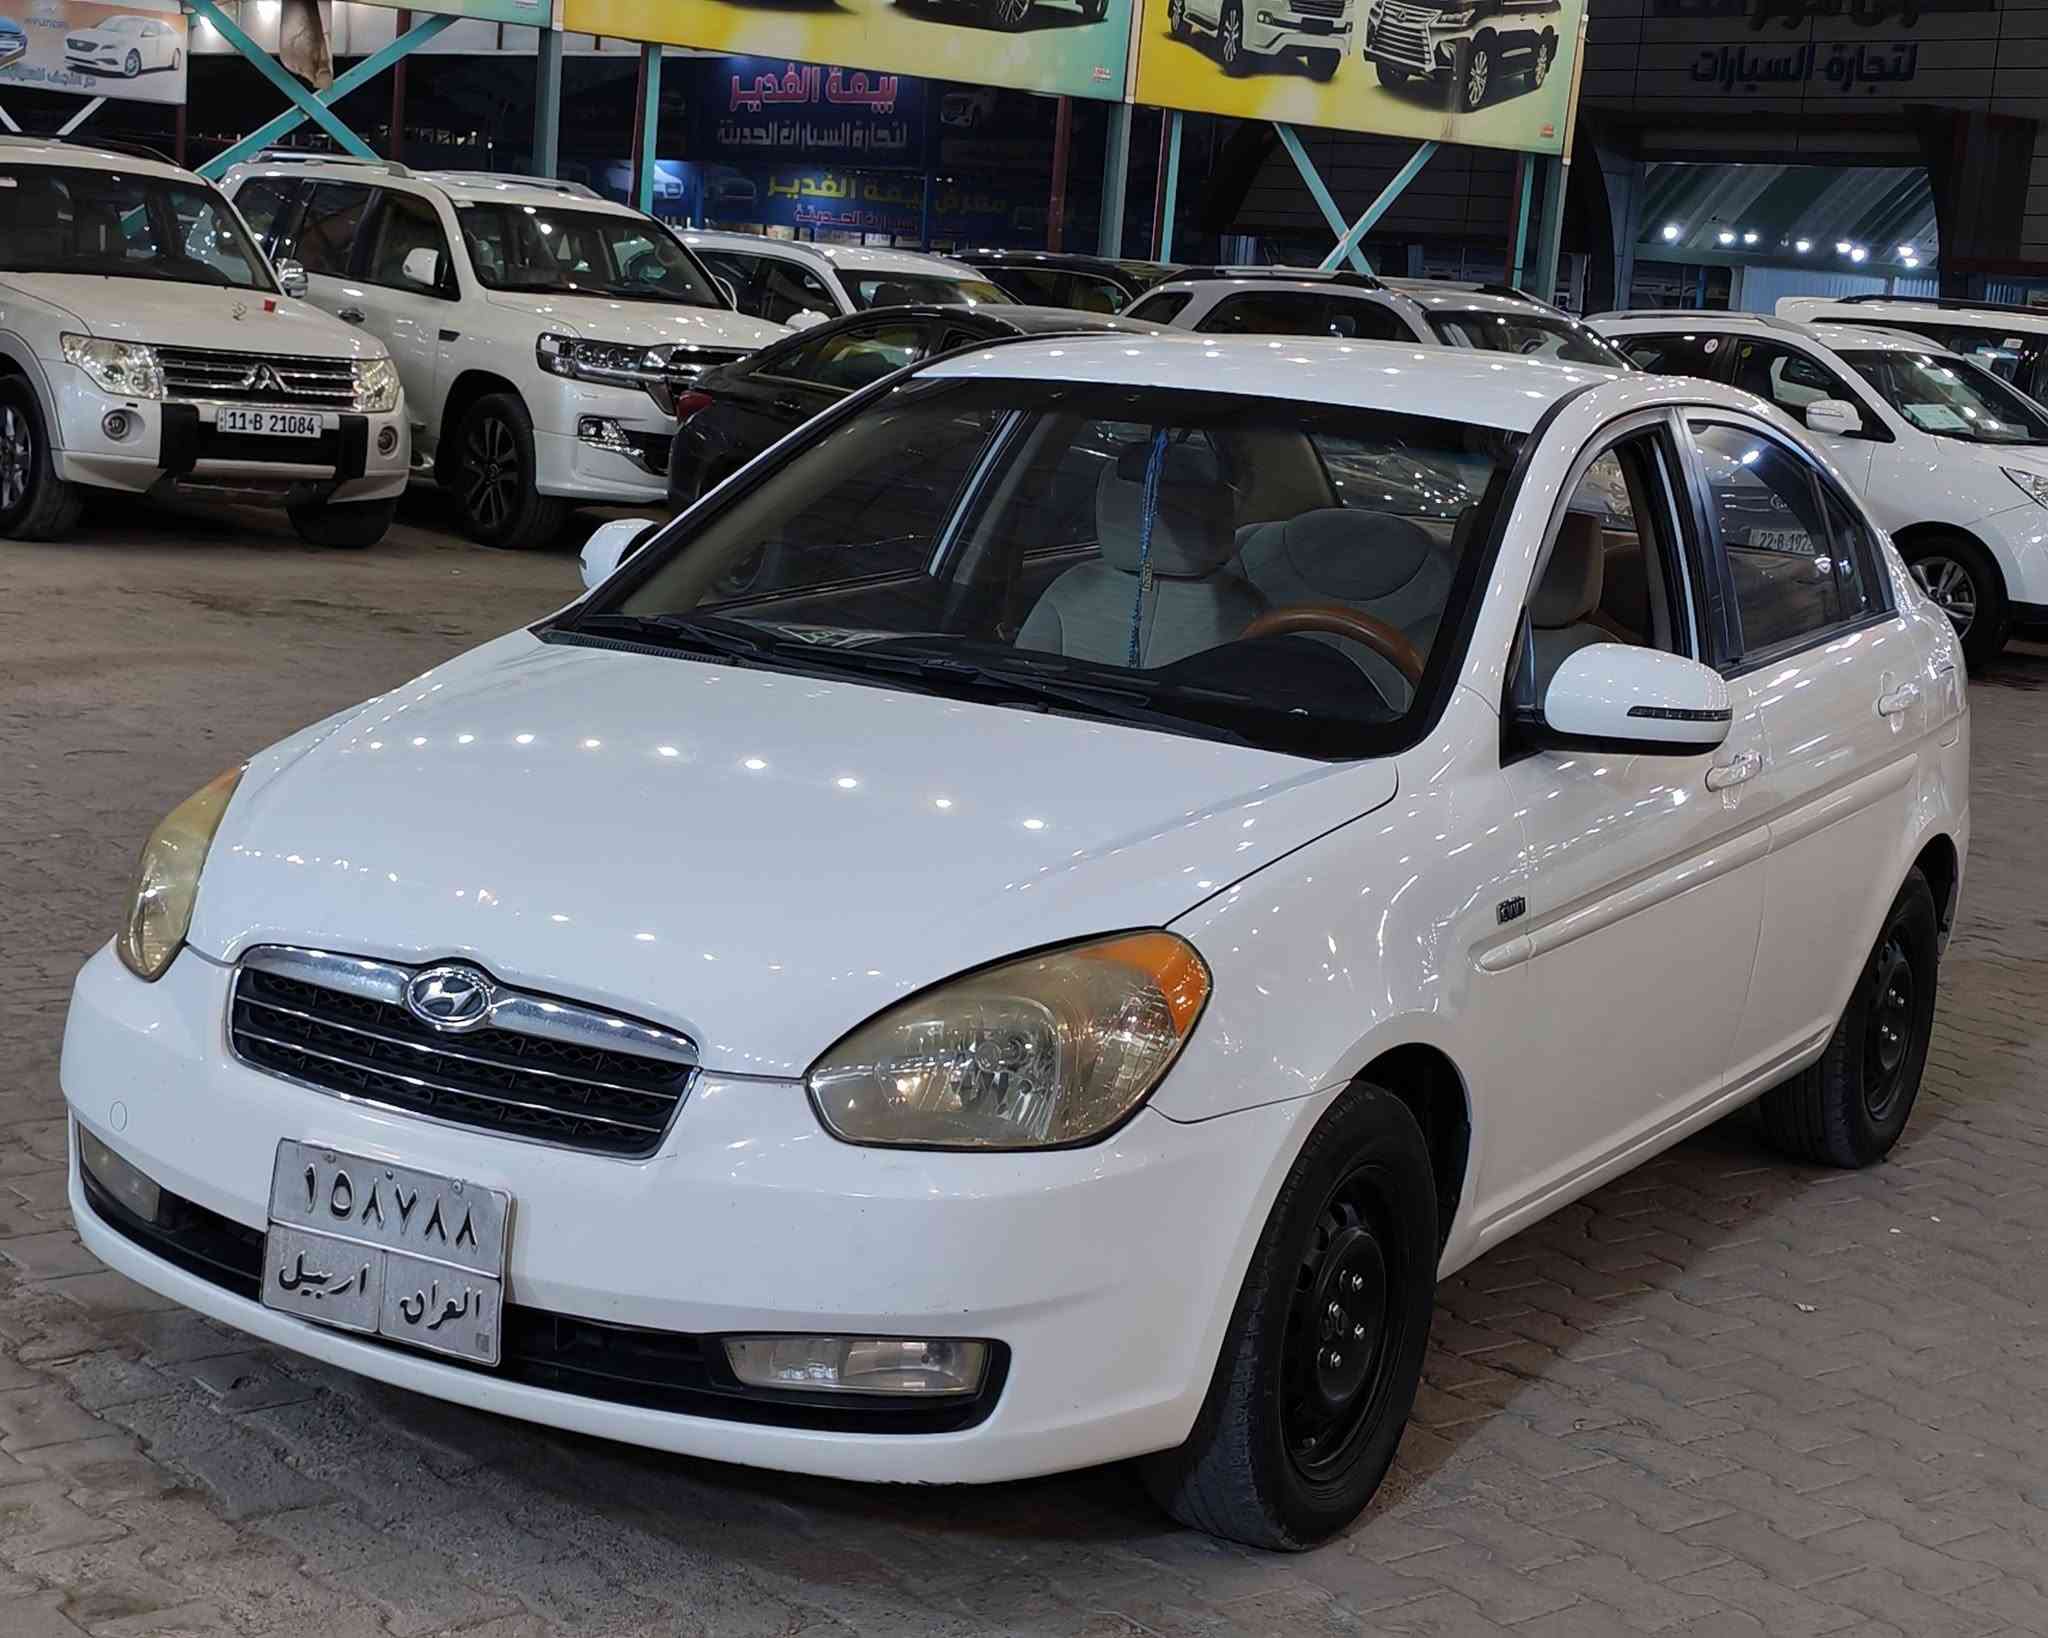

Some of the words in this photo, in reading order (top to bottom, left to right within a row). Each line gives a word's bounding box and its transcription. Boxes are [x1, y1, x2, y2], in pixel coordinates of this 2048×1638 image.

[729, 62, 821, 113] الغدير
[825, 66, 899, 114] بيعة
[1691, 41, 1817, 92] السيارات
[1825, 43, 1919, 93] لتجارة
[767, 173, 856, 200] الغدير
[269, 414, 315, 435] 21084
[304, 1163, 480, 1251] ١٥٨٧٨٨
[278, 1250, 371, 1300] اربيل
